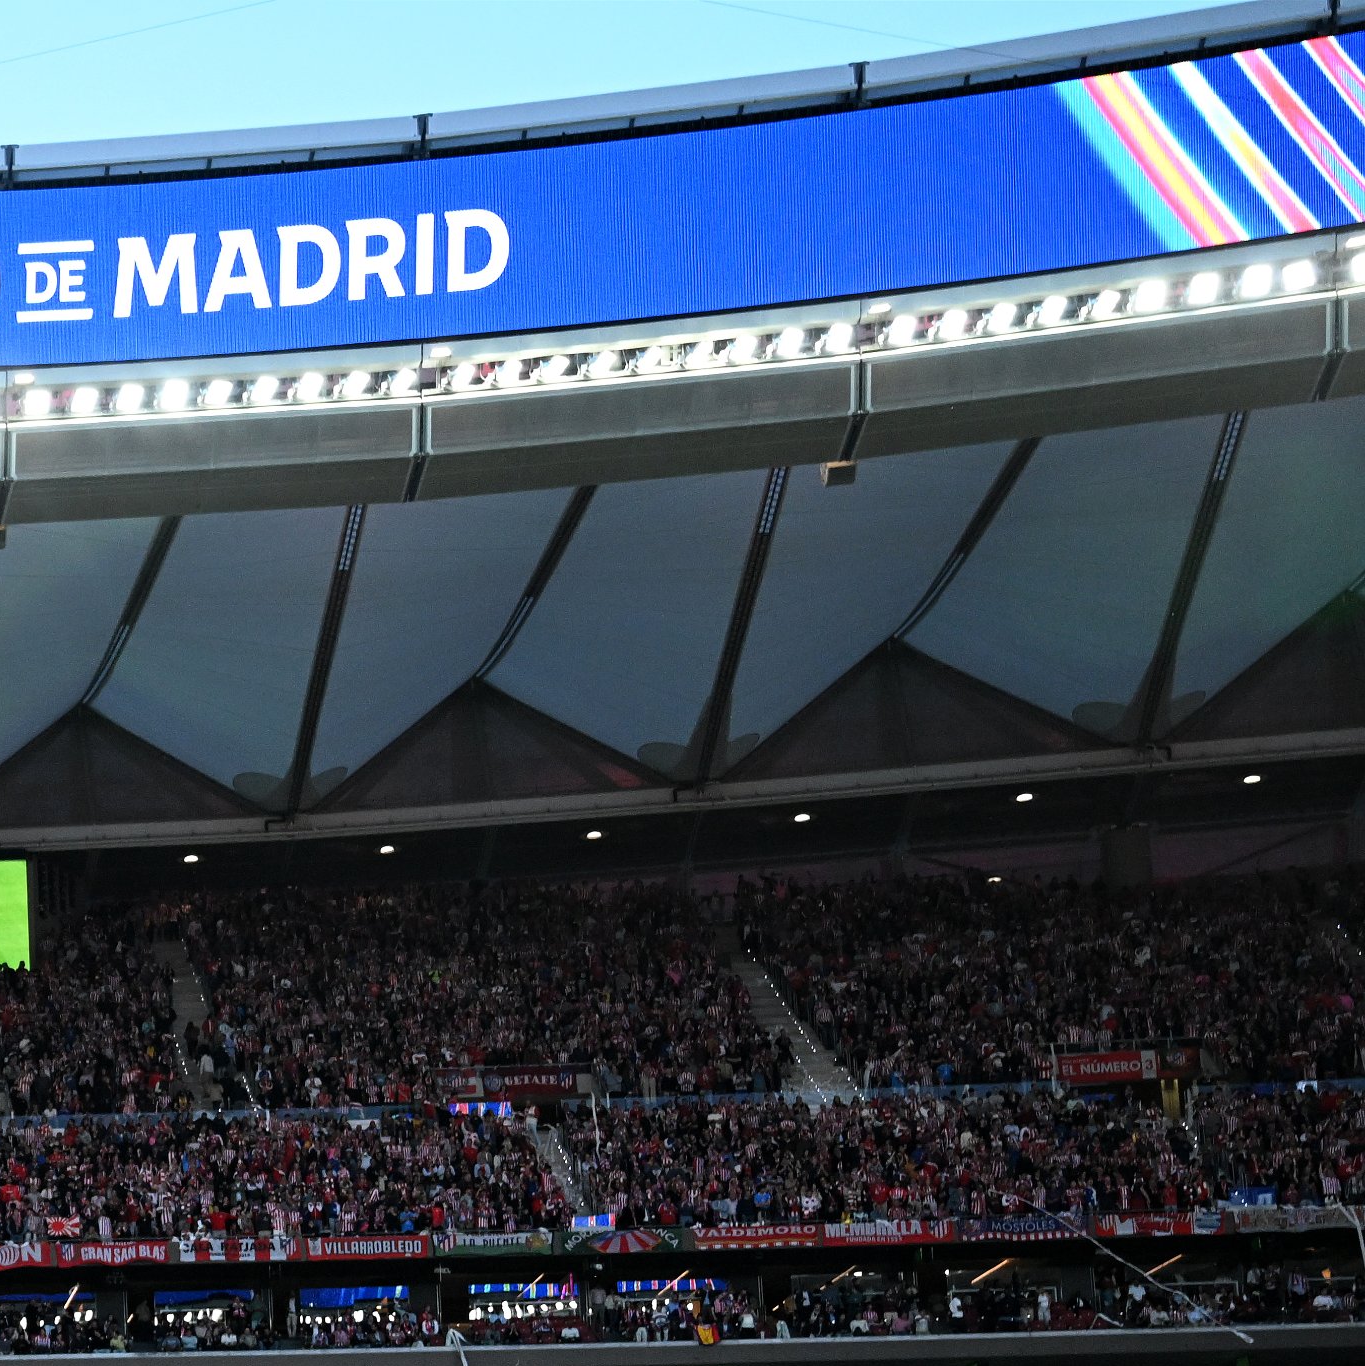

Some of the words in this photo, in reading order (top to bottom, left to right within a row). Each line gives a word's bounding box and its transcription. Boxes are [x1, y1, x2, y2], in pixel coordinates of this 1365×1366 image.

[26, 259, 86, 304] DE
[113, 208, 511, 319] MADRID
[1062, 1064, 1077, 1076] EL
[1080, 1059, 1141, 1075] NÚMERO
[504, 1073, 558, 1086] GETAFE
[694, 1225, 817, 1239] VALDEMORO
[80, 1246, 114, 1263] GRAN
[114, 1246, 137, 1263] SAN
[138, 1245, 166, 1260] BLAS
[325, 1239, 422, 1256] VILLARROBLEDO
